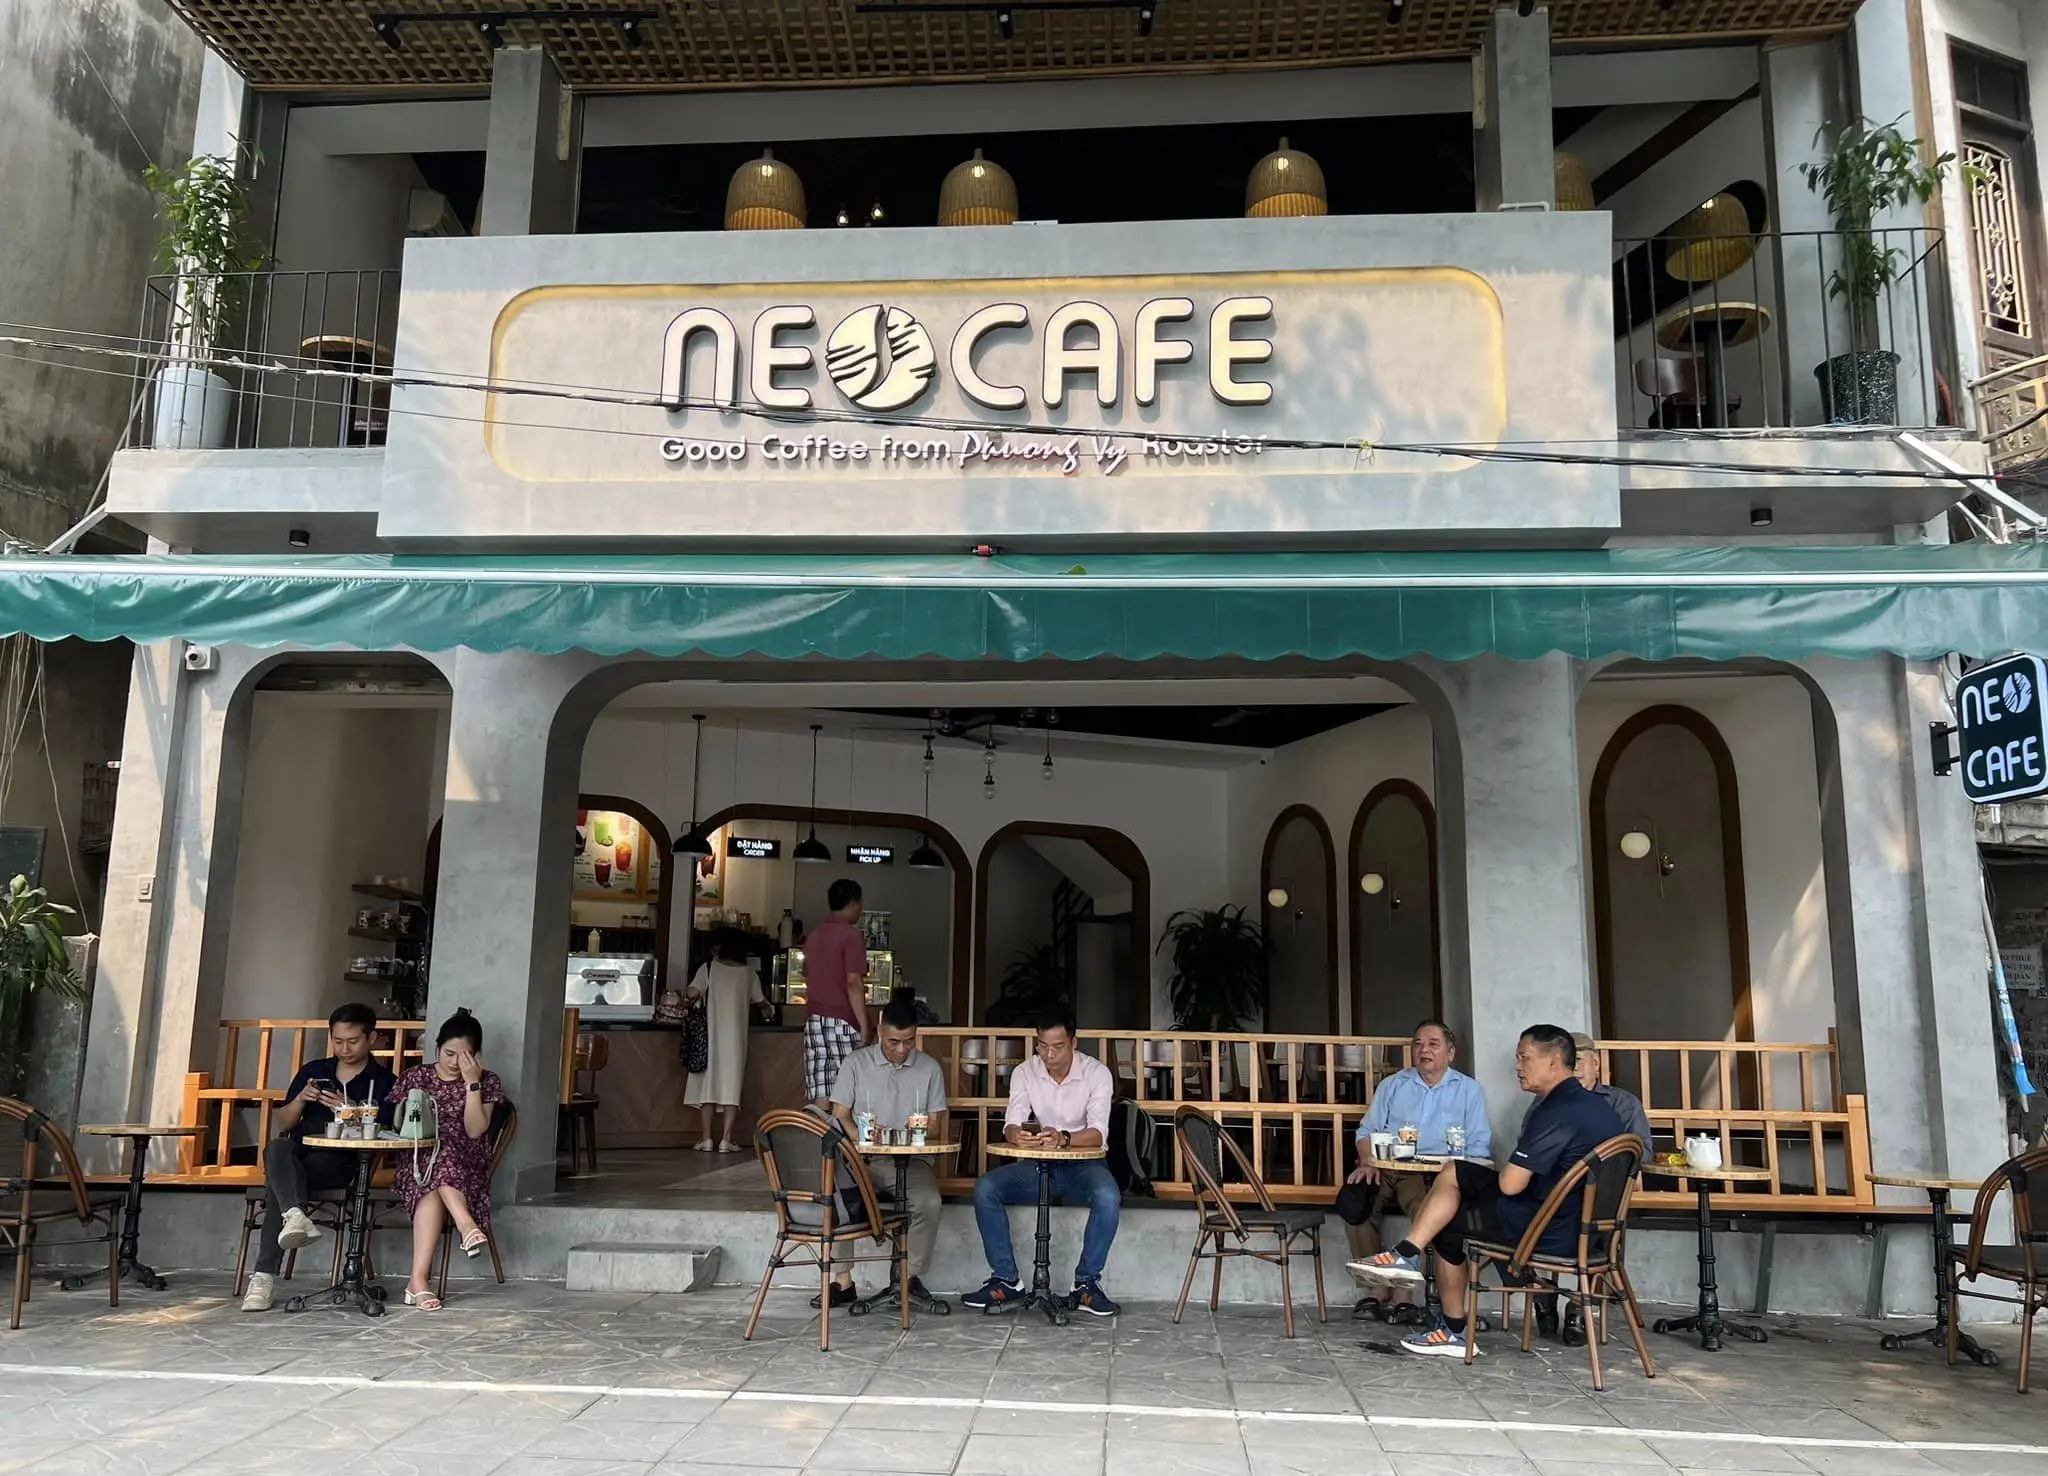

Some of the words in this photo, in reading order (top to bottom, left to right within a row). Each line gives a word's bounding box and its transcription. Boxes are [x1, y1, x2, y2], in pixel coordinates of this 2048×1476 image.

[949, 297, 1274, 408] CAFE
[659, 435, 747, 461] Good
[761, 434, 869, 460] Coffee
[880, 434, 952, 460] from
[1094, 435, 1129, 475] Vy
[1966, 735, 2040, 788] CAFE
[743, 849, 766, 857] ORDER
[859, 856, 873, 864] PICK
[873, 857, 882, 865] UP
